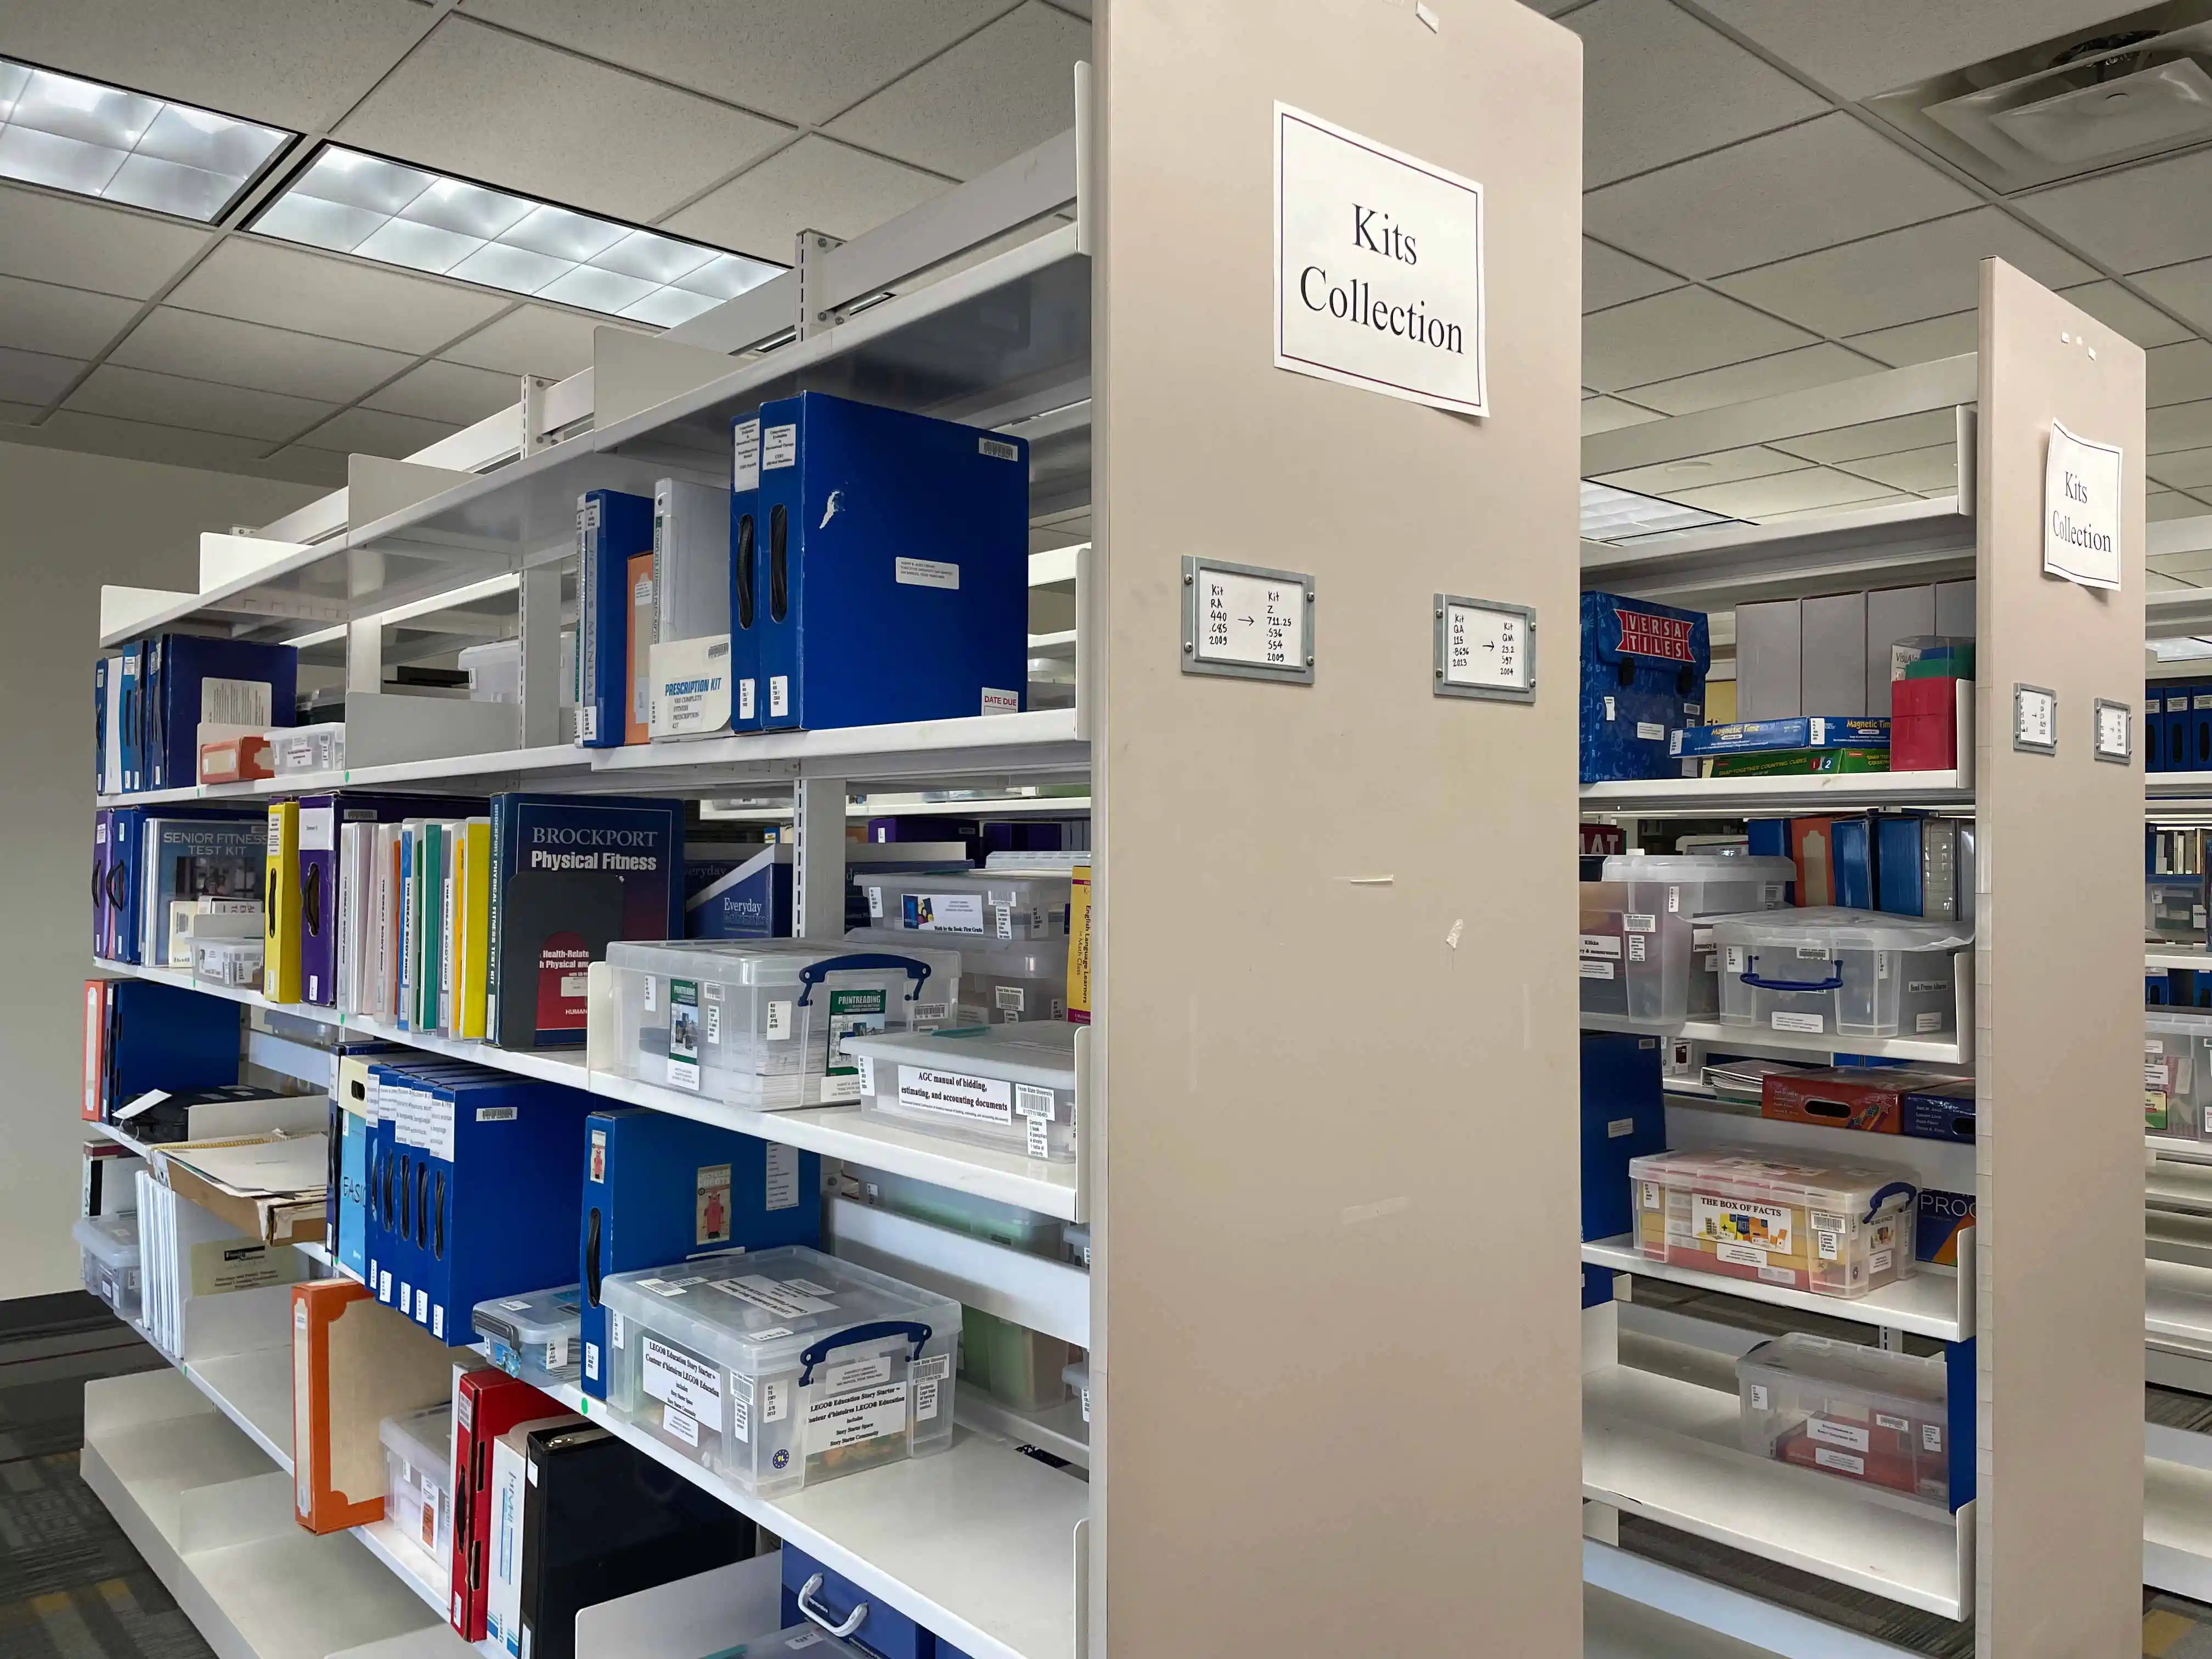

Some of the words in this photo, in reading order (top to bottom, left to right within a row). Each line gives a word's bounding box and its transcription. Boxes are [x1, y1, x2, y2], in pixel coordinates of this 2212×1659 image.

[1351, 203, 1418, 266] Kits
[1299, 264, 1464, 355] Collection
[2064, 470, 2087, 504] Kits
[2052, 509, 2112, 554] Collection
[1211, 584, 1224, 596] Kit
[1268, 591, 1279, 602] Kit
[1210, 598, 1223, 608] RA
[1267, 605, 1274, 614] Z
[1210, 610, 1227, 622] 440
[1455, 613, 1464, 623] Kit
[1266, 617, 1292, 627] 711.25
[1503, 622, 1513, 631] Kit
[1628, 614, 1681, 638] VERSA
[1453, 624, 1464, 634] QA
[1209, 635, 1227, 646] 2009
[1453, 636, 1464, 645] 115
[1502, 634, 1514, 642] QM
[1502, 646, 1515, 654] 23.2
[1629, 635, 1681, 658] TILES
[1267, 653, 1284, 662] 2009
[1452, 659, 1468, 667] 2013
[1500, 668, 1514, 676] 2004
[665, 678, 710, 697] PRESCRIPTION
[710, 677, 722, 691] KIT
[984, 695, 1002, 704] DATE
[1003, 697, 1017, 706] DUE
[1847, 719, 1877, 730] Magnetic
[1711, 725, 1741, 736] Magnetic
[1824, 759, 1831, 769] 2
[163, 832, 214, 844] SENIOR
[217, 833, 268, 845] FITNESS
[532, 827, 658, 847] BROCKPORT
[188, 845, 222, 856] TEST
[225, 846, 247, 856] KIT
[532, 850, 599, 871] Physical
[602, 851, 657, 871] Fitness
[724, 897, 762, 915] Everyday
[1082, 931, 1091, 969] Language
[546, 960, 576, 970] Physical
[1081, 970, 1090, 1003] Learners
[838, 994, 881, 1005] PRINTREADING
[918, 1071, 933, 1082] AGC
[934, 1075, 955, 1085] manual
[956, 1077, 962, 1086] of
[963, 1078, 988, 1092] bidding,
[901, 1086, 930, 1100] estimating,
[931, 1091, 942, 1101] and
[943, 1094, 974, 1108] accounting
[975, 1097, 1008, 1111] documents
[1036, 1088, 1053, 1098] University
[1700, 1197, 1718, 1206] THE
[1720, 1200, 1737, 1210] BOX
[1740, 1203, 1752, 1212] OF
[1753, 1205, 1781, 1217] FACTS
[667, 1349, 686, 1366] Education
[687, 1359, 698, 1373] Story
[698, 1365, 713, 1379] Starter
[645, 1353, 662, 1367] Conteur
[699, 1380, 720, 1397] Education
[833, 1395, 860, 1406] Education
[861, 1391, 876, 1400] Story
[876, 1387, 895, 1396] Starter
[808, 1414, 826, 1424] onteur
[827, 1408, 855, 1419] d'histoires
[878, 1396, 905, 1407] Education
[847, 1415, 864, 1424] includes
[856, 1430, 879, 1440] Community
